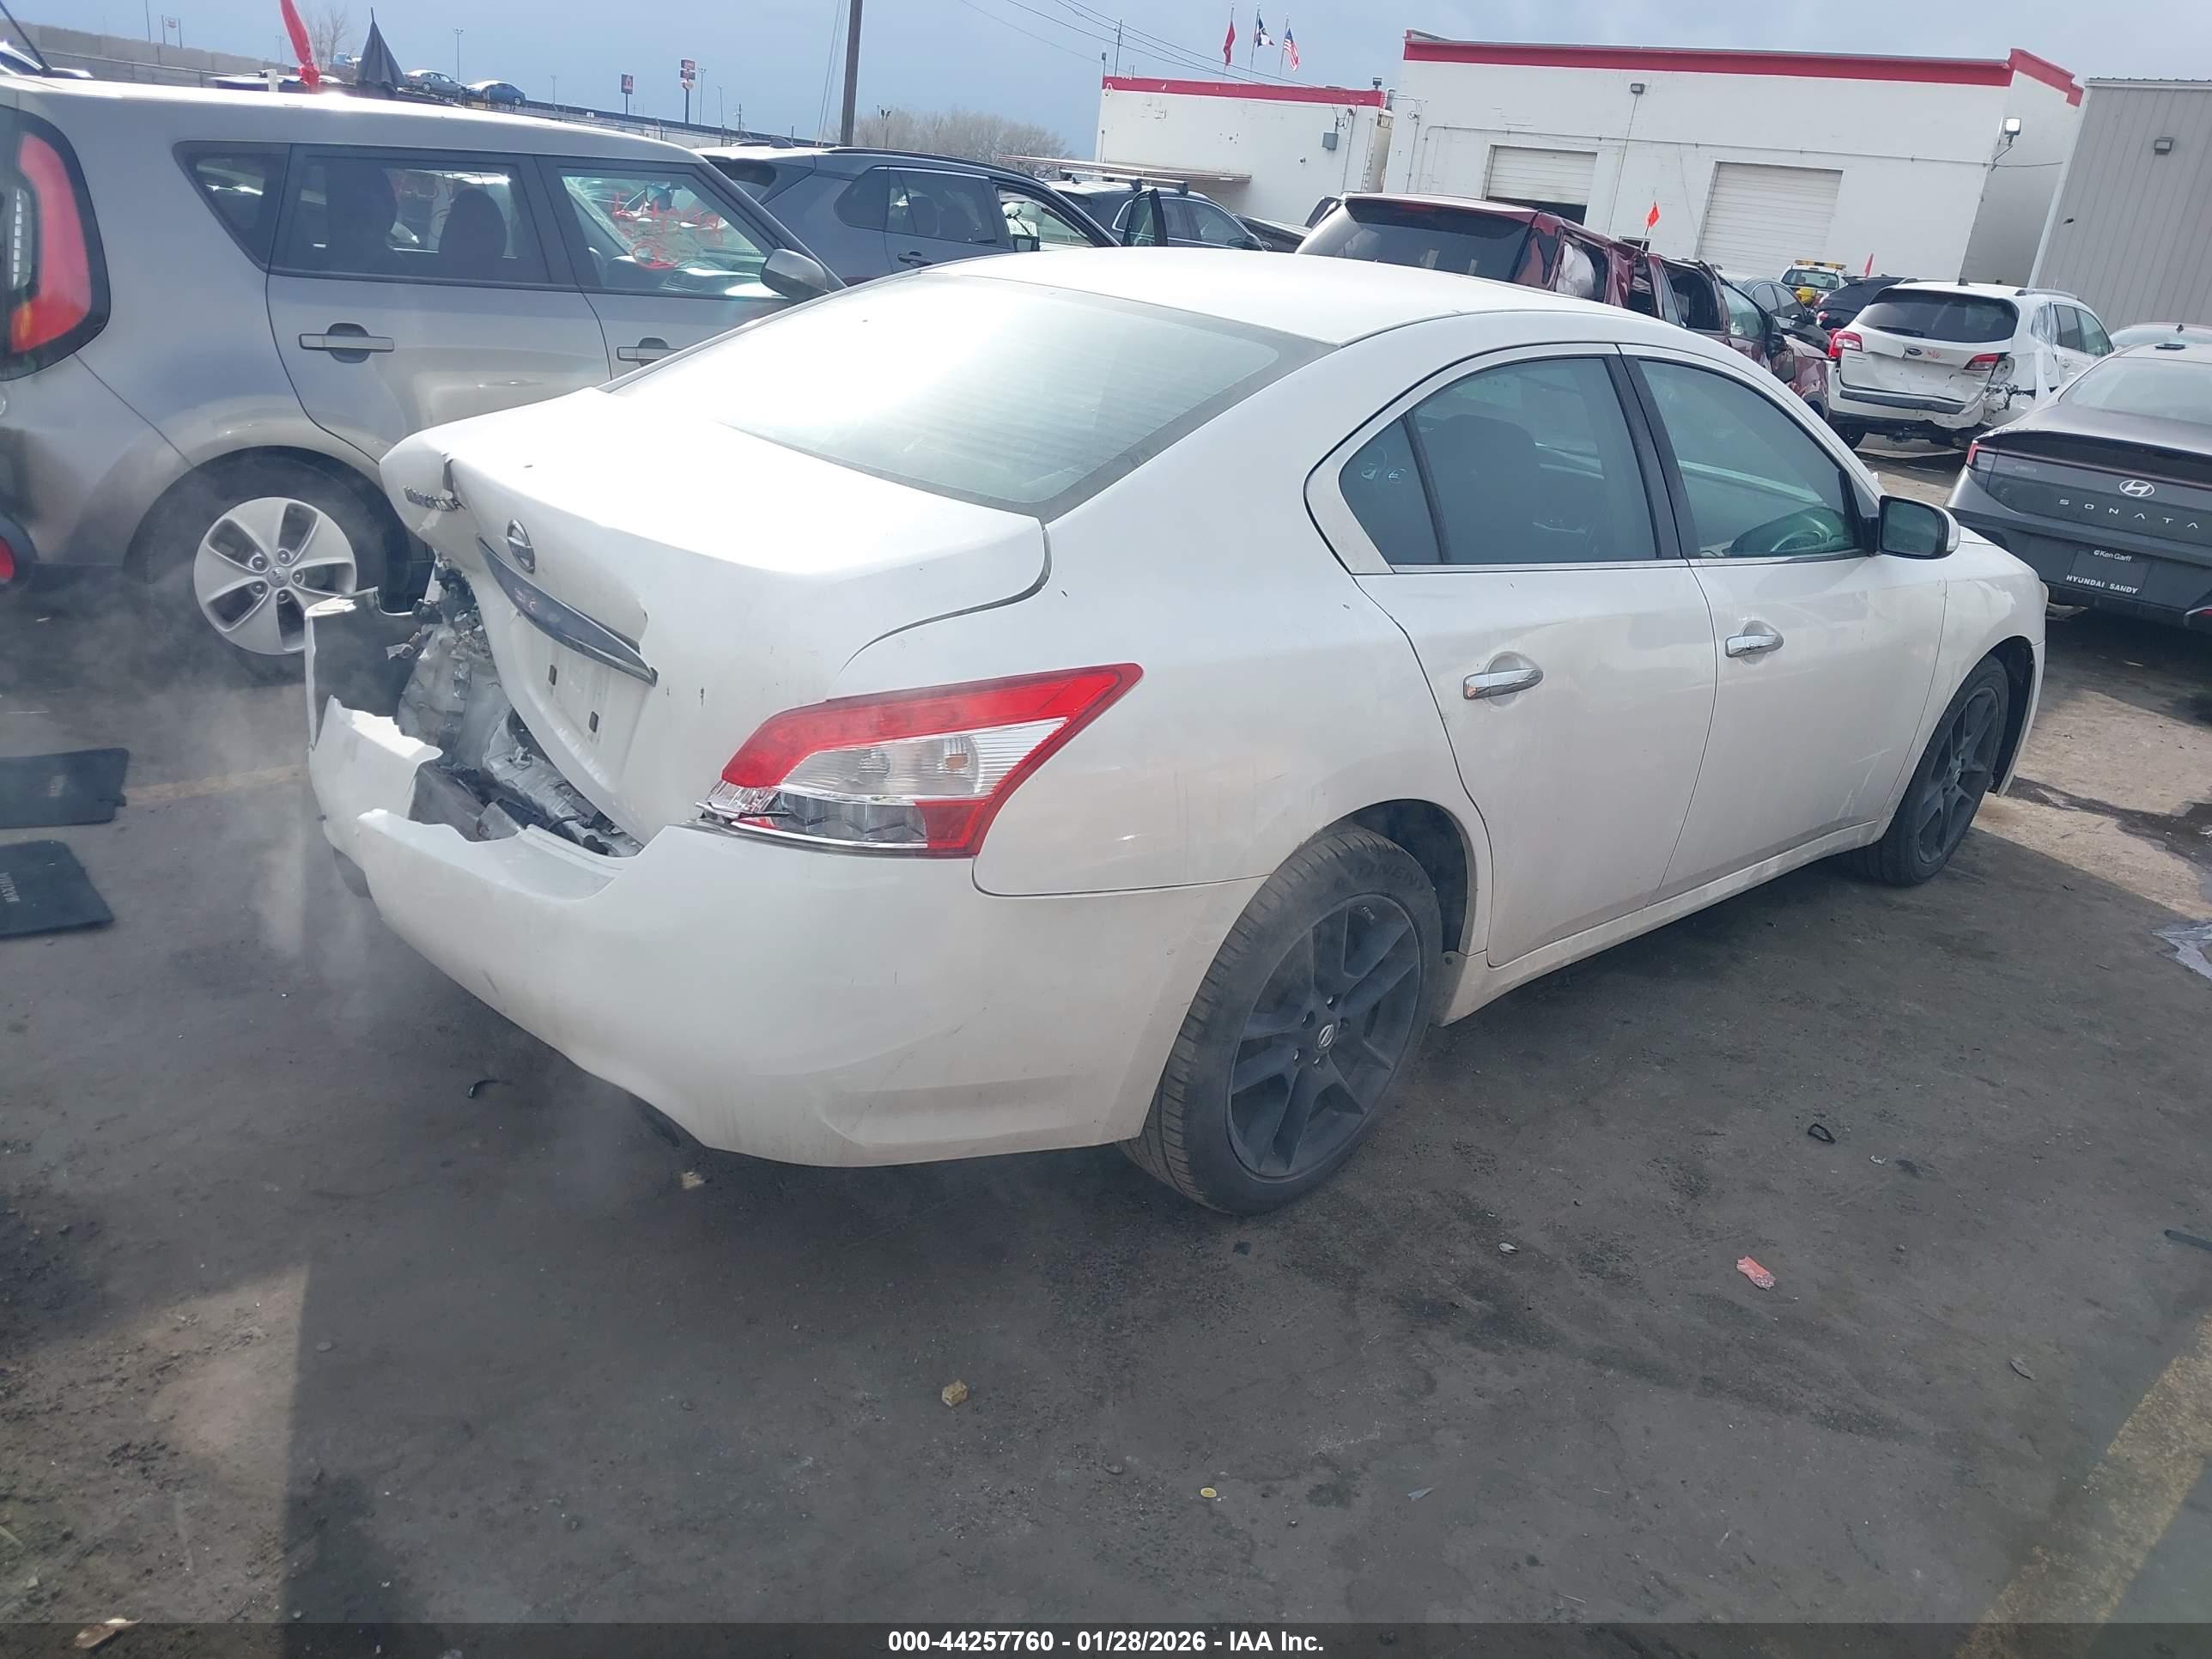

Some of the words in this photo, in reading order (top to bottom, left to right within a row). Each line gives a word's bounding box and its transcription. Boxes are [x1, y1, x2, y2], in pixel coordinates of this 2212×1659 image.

[2058, 499, 2199, 529] SONATA
[2114, 553, 2132, 562] Garff
[2066, 574, 2106, 588] HYUNDAI
[2109, 583, 2138, 594] SANDY
